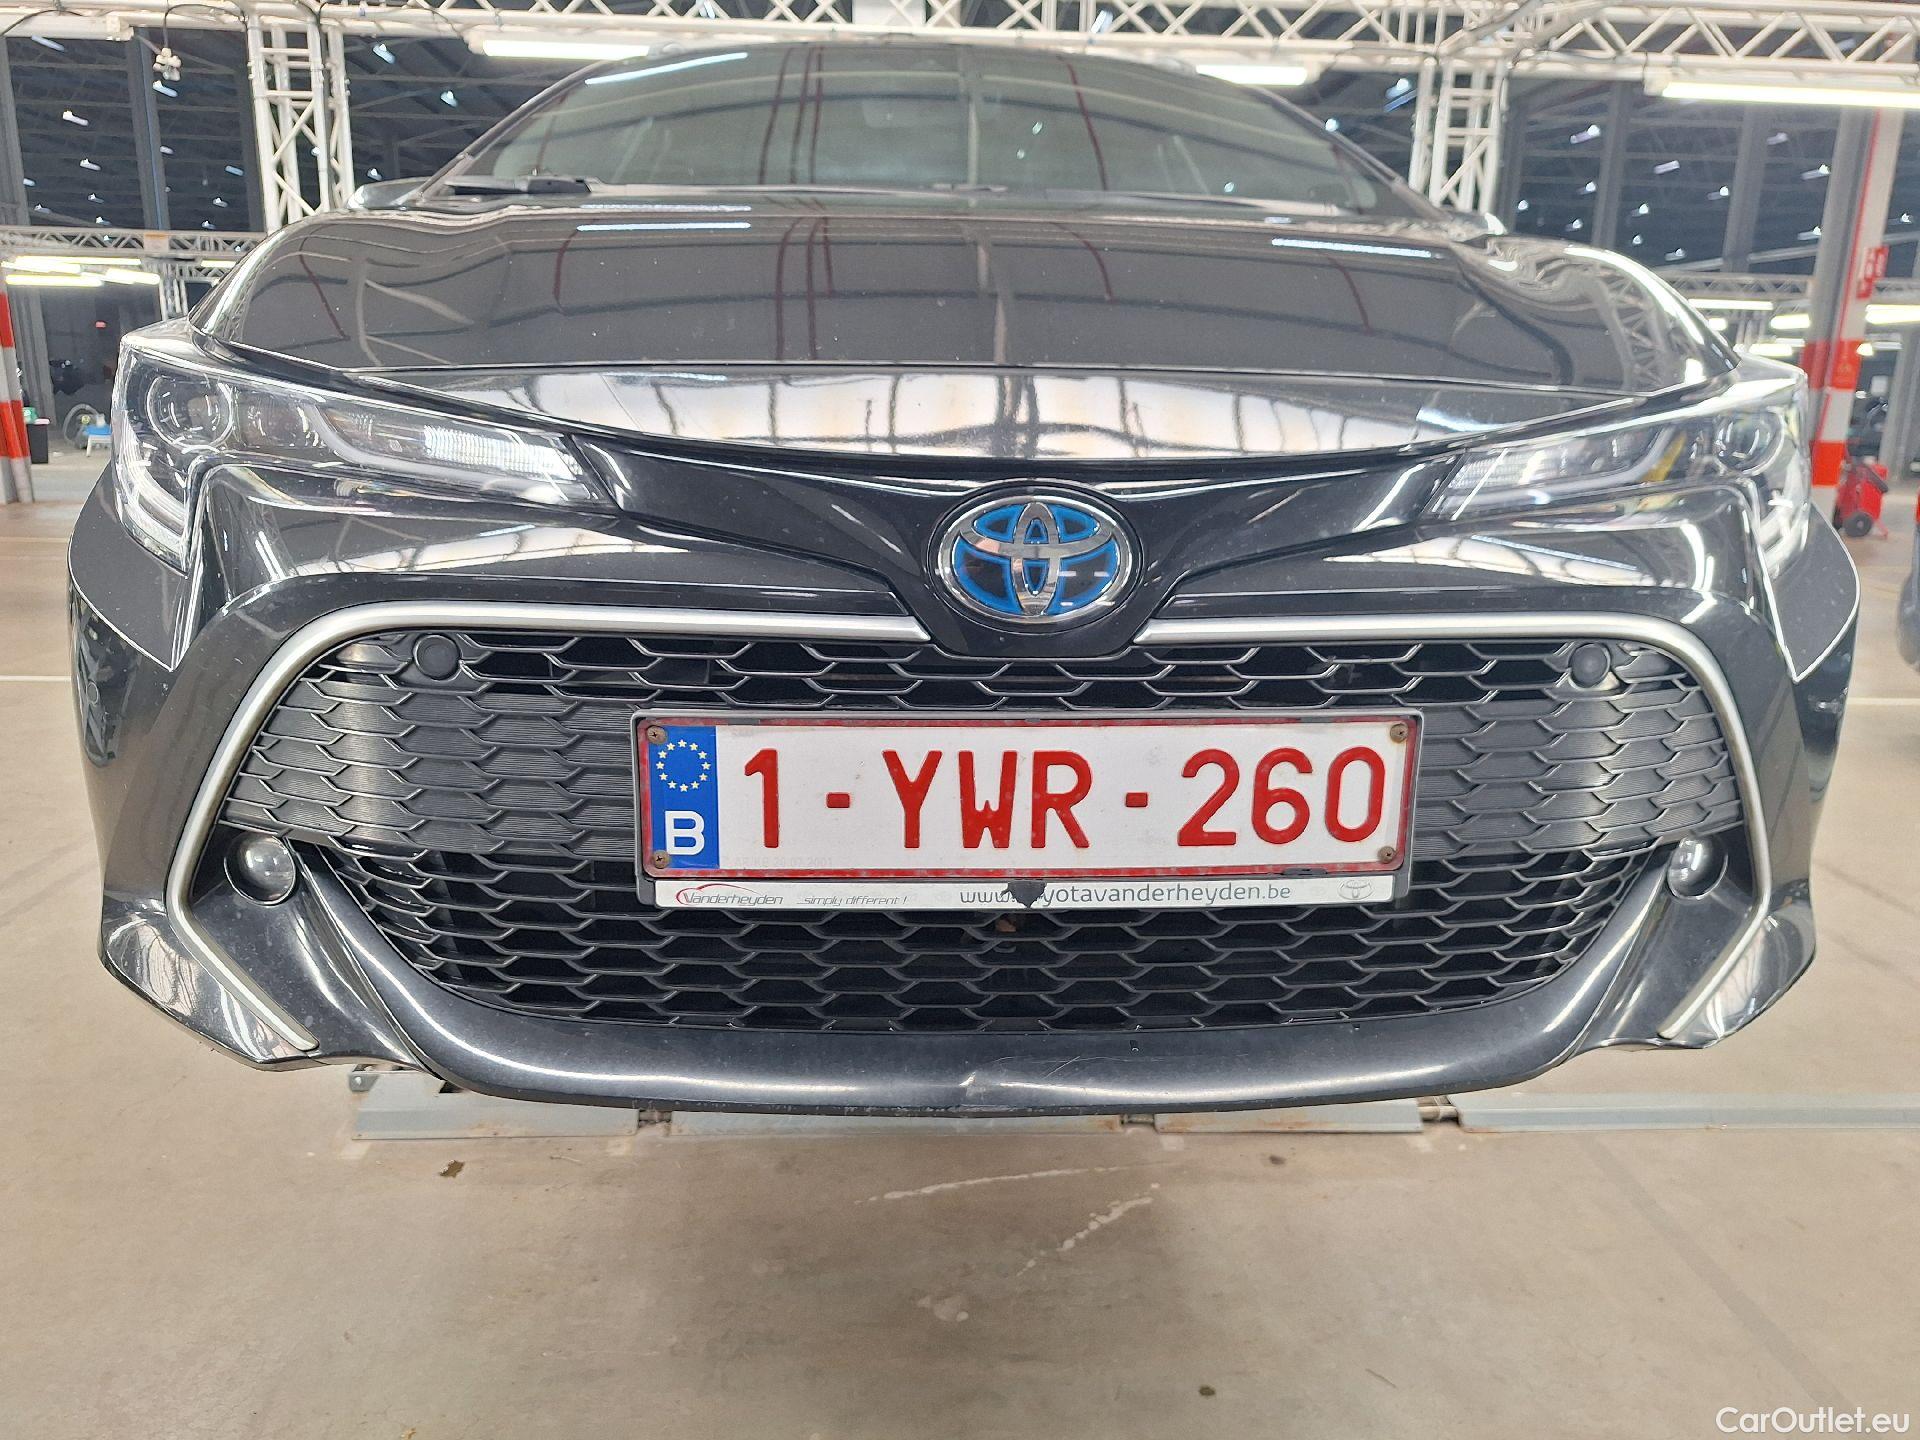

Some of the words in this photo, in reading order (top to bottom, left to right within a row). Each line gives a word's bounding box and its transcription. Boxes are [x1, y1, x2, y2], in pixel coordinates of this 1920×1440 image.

[664, 810, 706, 856] B
[683, 892, 783, 906] Vanderheyden
[845, 895, 900, 905] different
[960, 881, 1291, 907] www.yotavanderheyden.be
